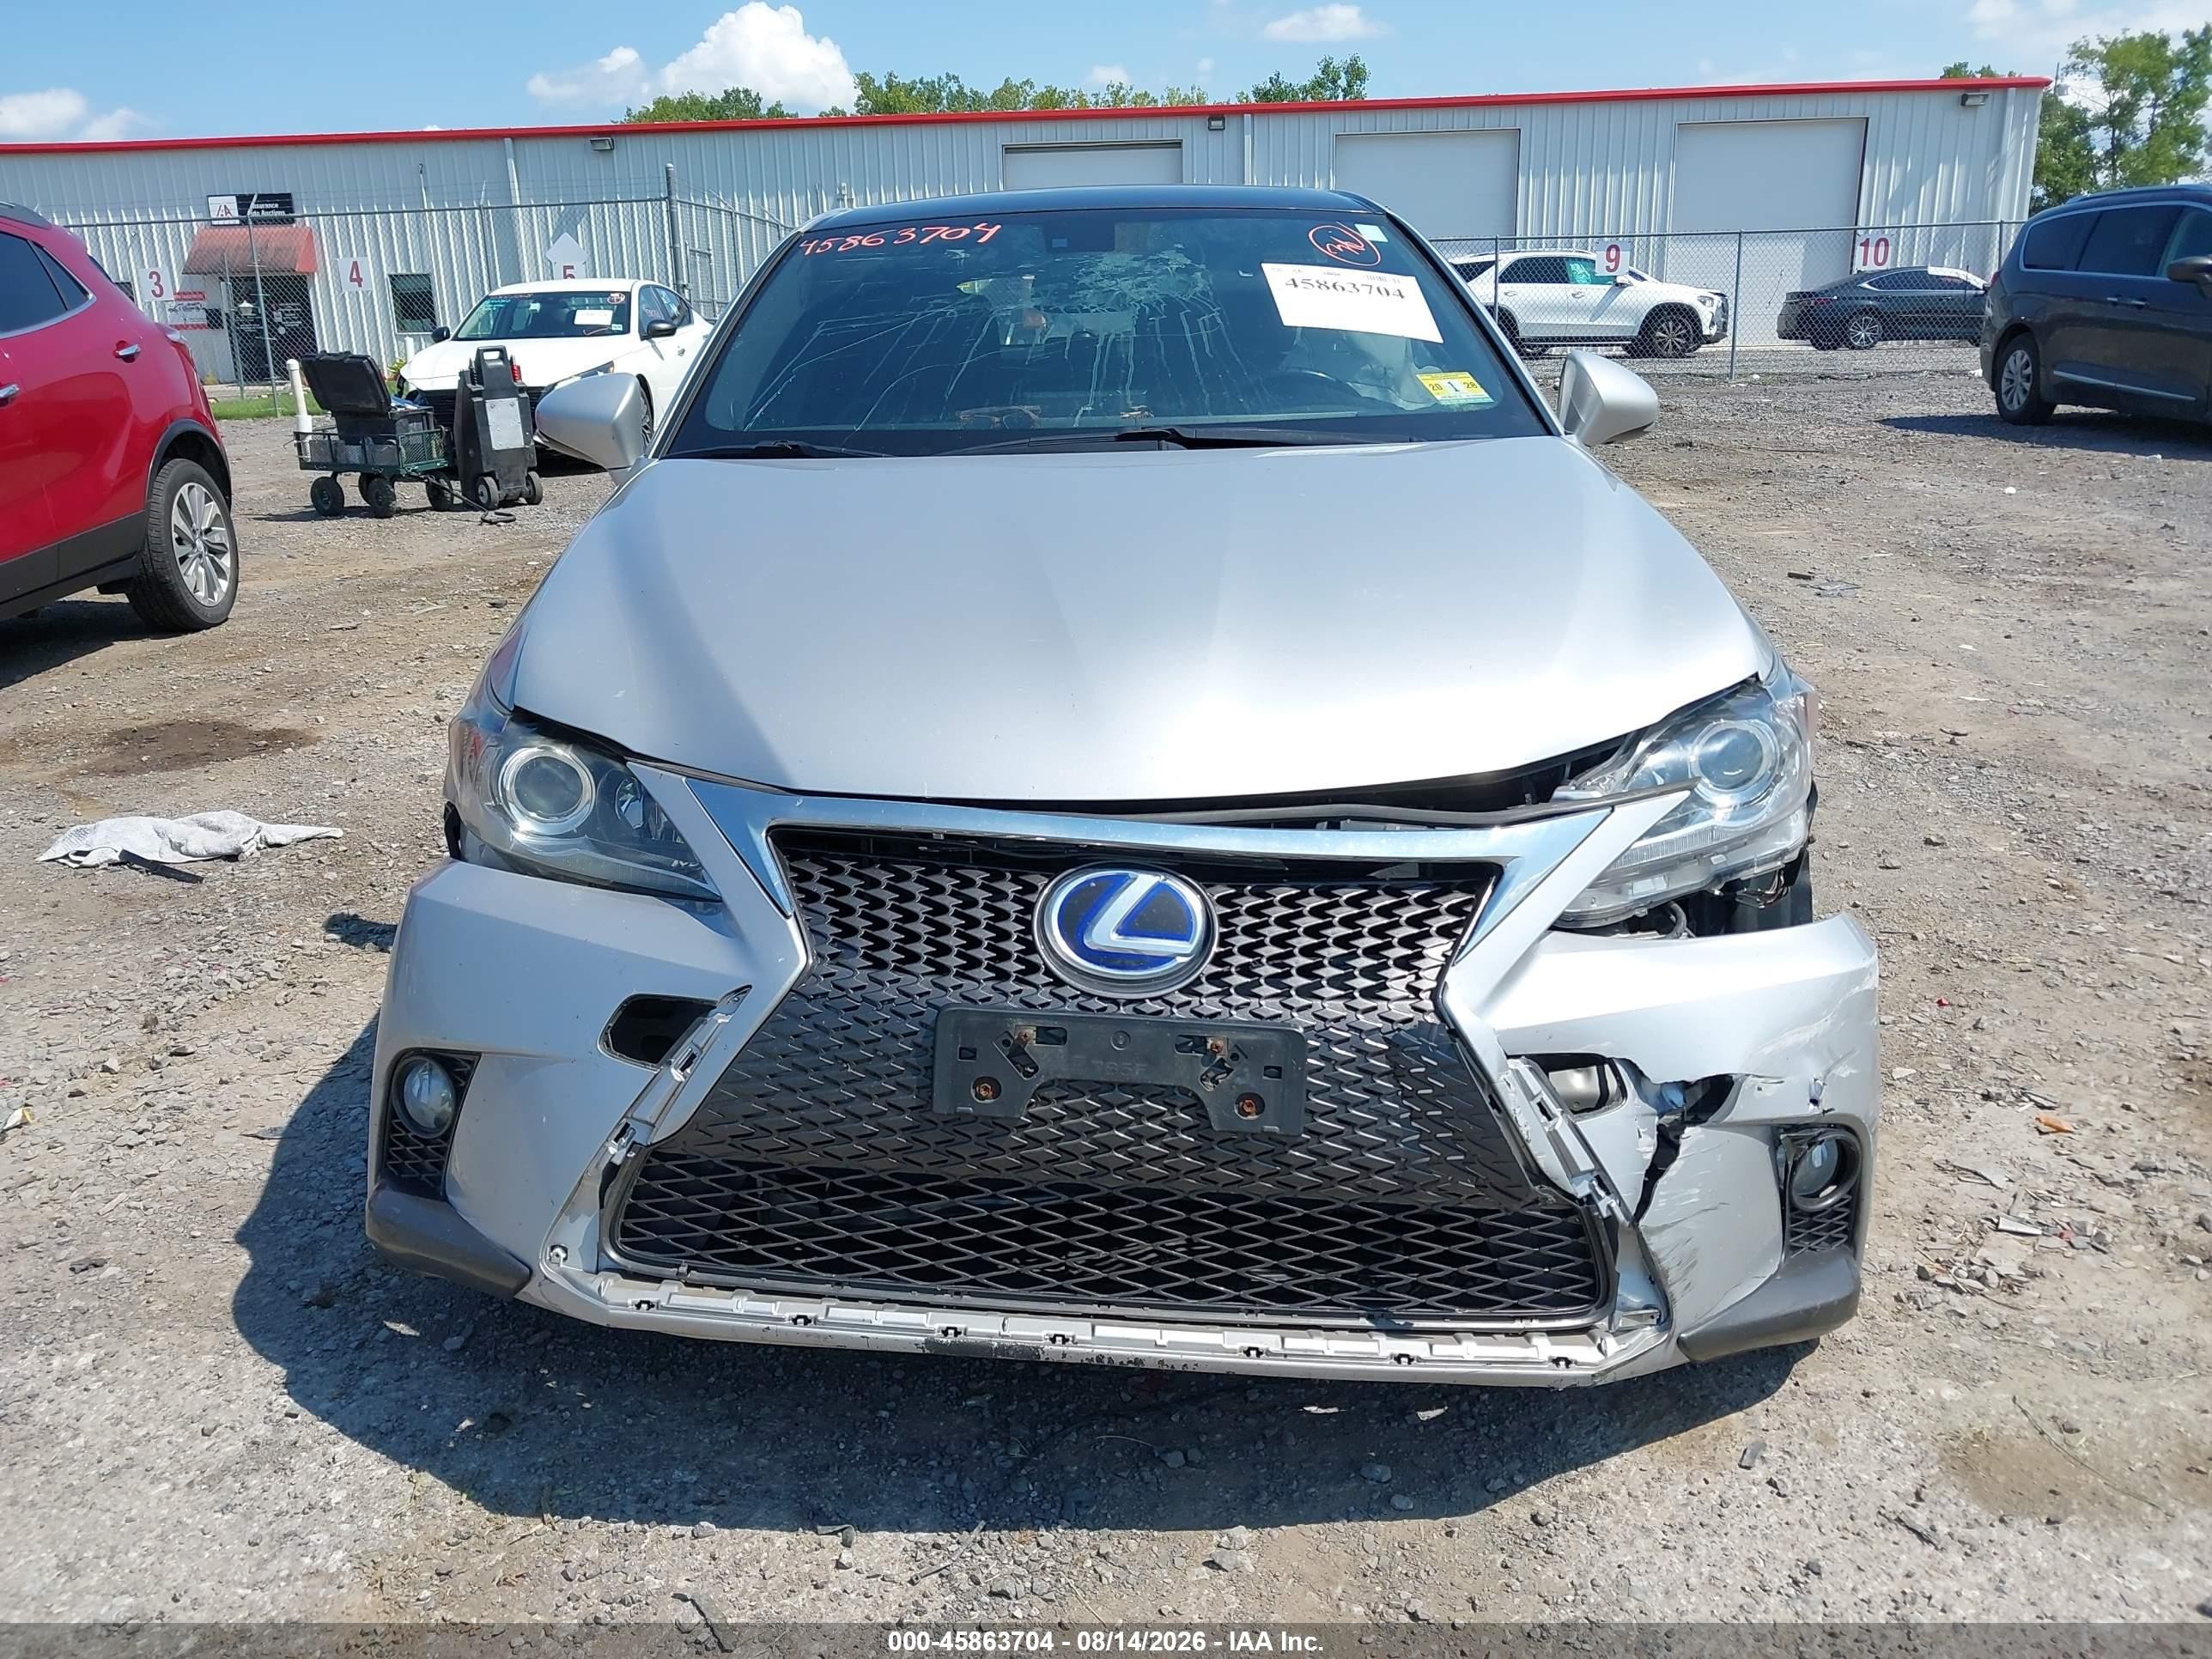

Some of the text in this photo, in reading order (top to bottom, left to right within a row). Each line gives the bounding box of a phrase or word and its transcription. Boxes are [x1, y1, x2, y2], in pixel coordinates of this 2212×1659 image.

[799, 222, 1001, 256] 45863704
[1859, 237, 1890, 267] 10
[1605, 244, 1621, 273] 9
[149, 270, 164, 298] 3
[349, 260, 363, 288] 4
[1285, 277, 1406, 300] 45863704
[1429, 381, 1478, 392] 20 1 28
